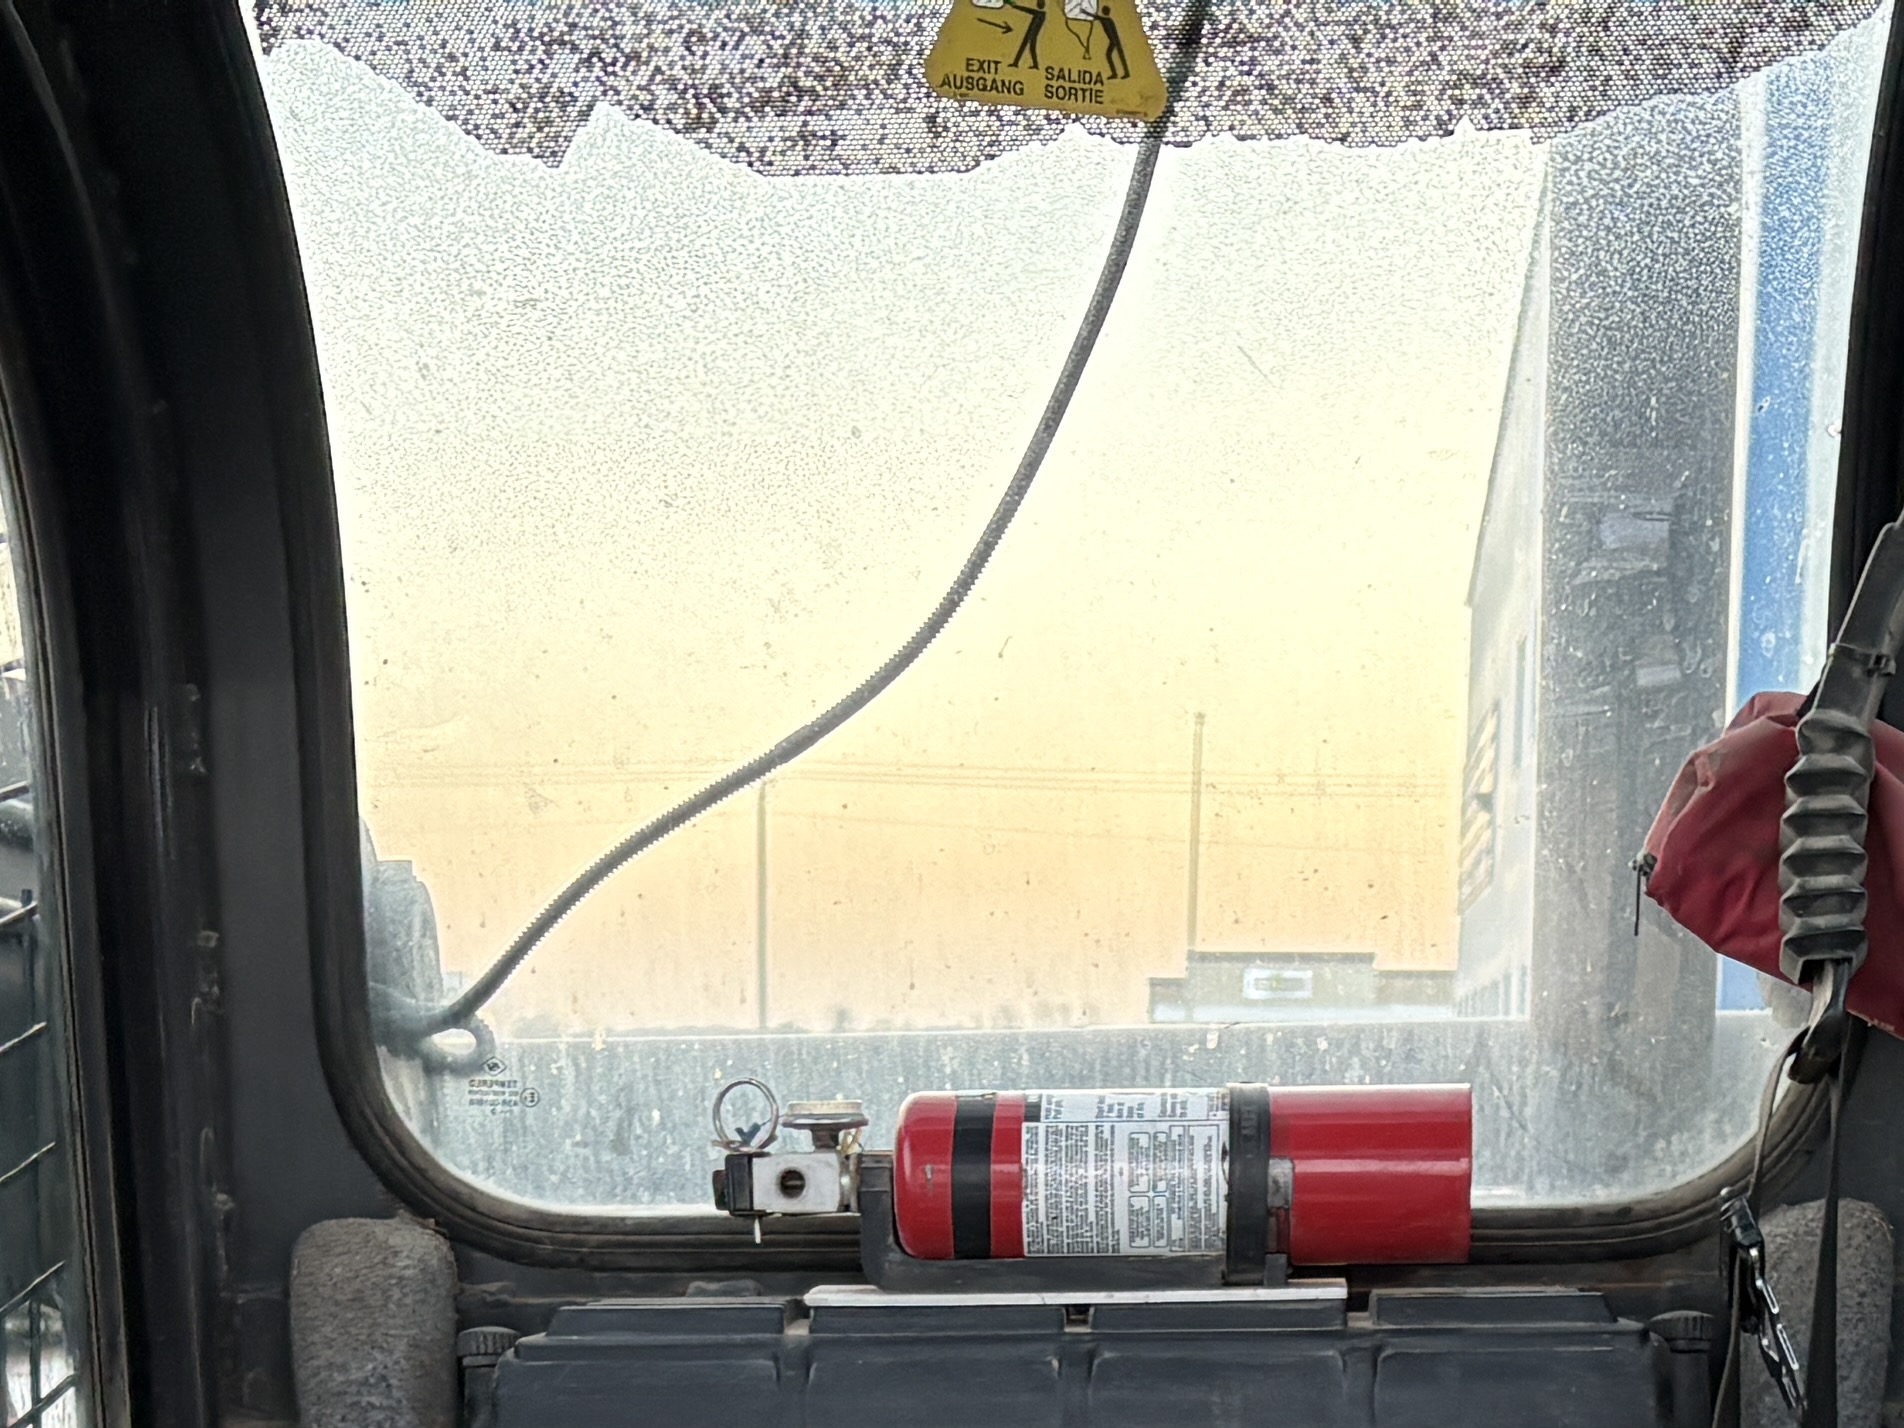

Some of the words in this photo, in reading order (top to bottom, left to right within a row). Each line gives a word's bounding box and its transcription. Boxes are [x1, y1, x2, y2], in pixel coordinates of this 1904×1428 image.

[965, 57, 1002, 75] EXIT
[1044, 66, 1105, 87] SALIDA
[938, 73, 1025, 96] AUSGANG
[1044, 84, 1105, 105] SORTIE
